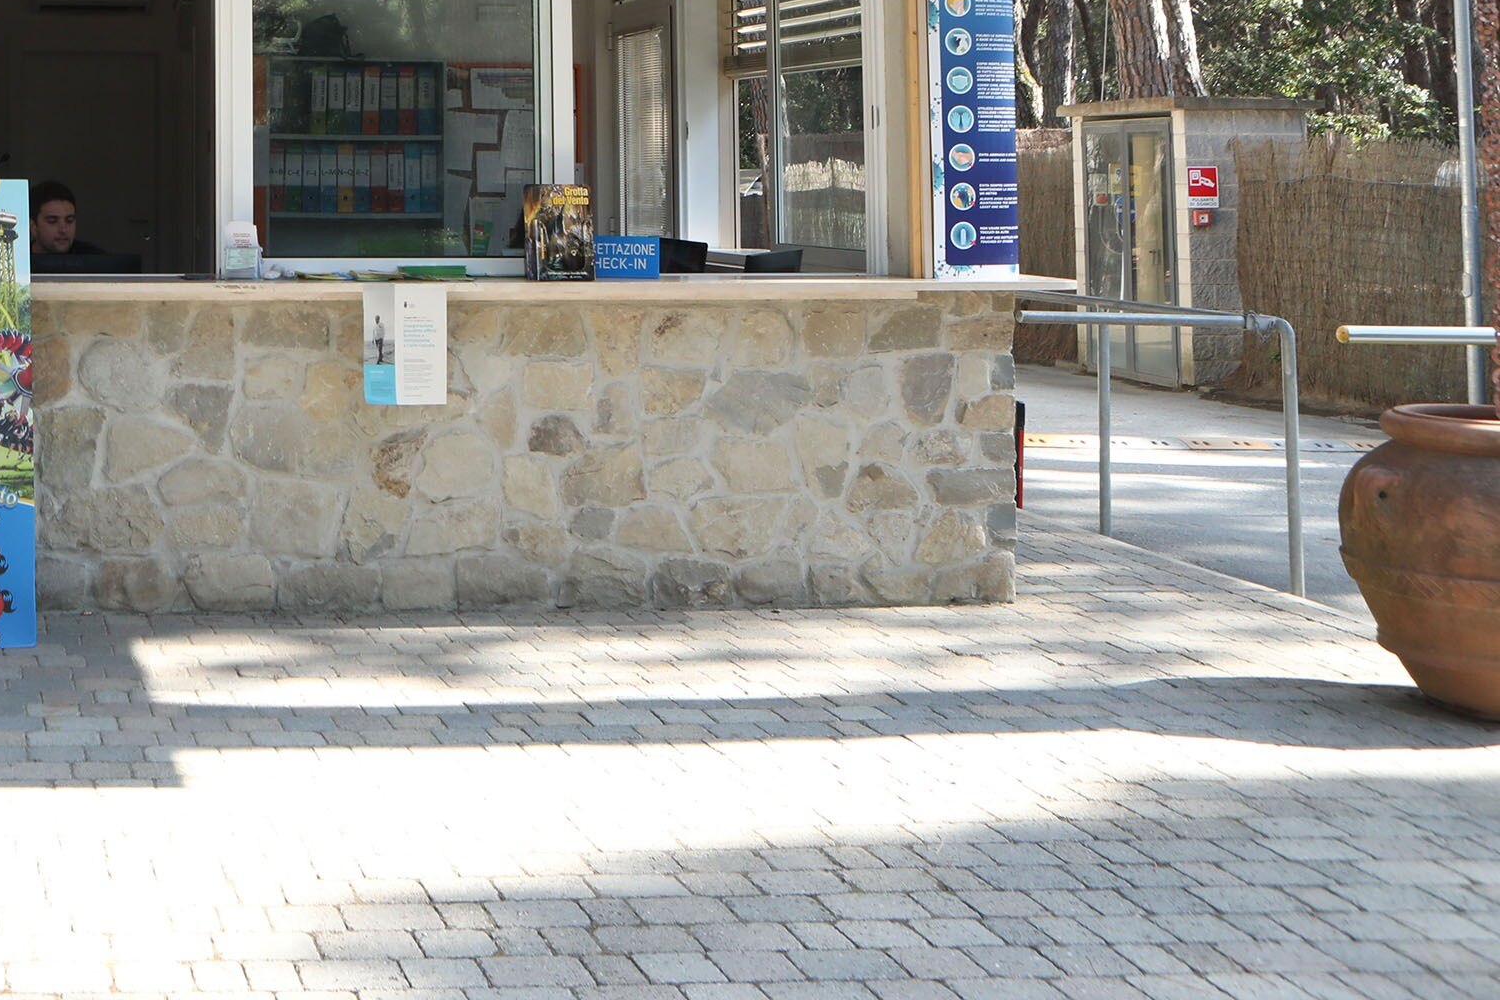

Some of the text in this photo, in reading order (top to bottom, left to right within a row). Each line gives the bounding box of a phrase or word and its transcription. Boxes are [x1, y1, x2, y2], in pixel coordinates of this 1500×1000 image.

[564, 186, 589, 197] Grotta
[552, 196, 589, 206] del Vento
[595, 257, 647, 270] HECK-IN
